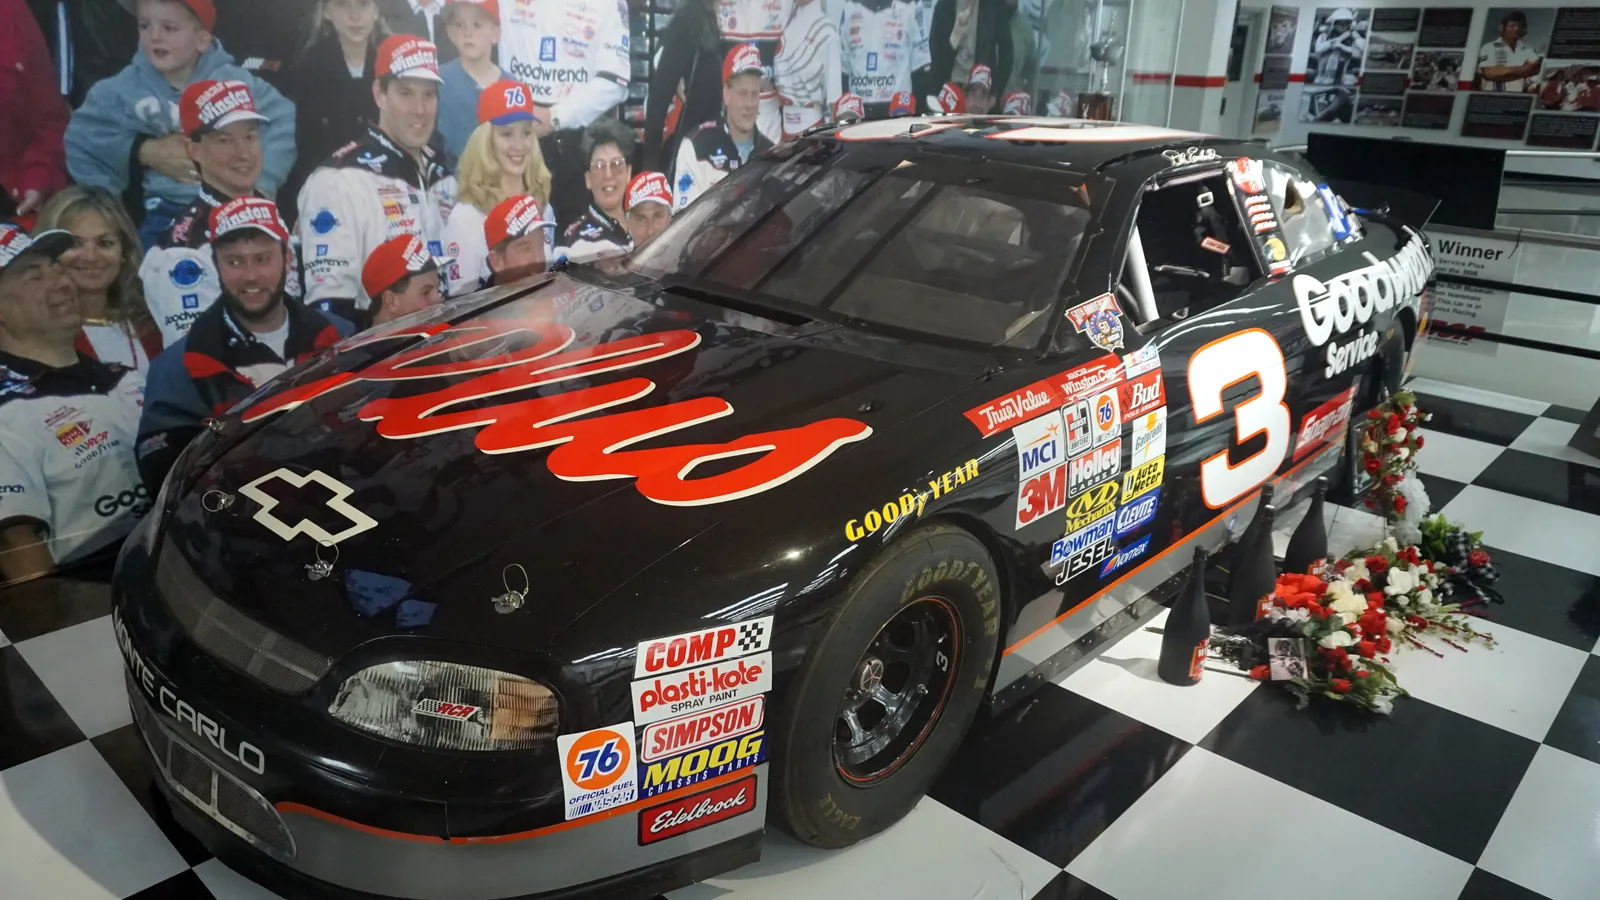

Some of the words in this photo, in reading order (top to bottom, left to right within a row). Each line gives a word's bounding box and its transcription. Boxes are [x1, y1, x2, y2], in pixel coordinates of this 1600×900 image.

[510, 56, 588, 83] Goodwrench
[504, 87, 524, 105] 76
[1438, 239, 1504, 260] Winner
[1325, 328, 1379, 380] Service
[1061, 374, 1097, 395] Winston
[1132, 373, 1161, 409] Bud
[1099, 402, 1112, 424] 76
[1187, 328, 1291, 510] 3
[1022, 439, 1057, 473] MCI
[1070, 445, 1120, 487] Holley
[1136, 461, 1159, 481] Auto
[1018, 463, 1067, 524] 3M
[1070, 473, 1108, 495] CARBS
[1133, 472, 1161, 494] Meter
[1052, 518, 1114, 563] Bowman
[1056, 537, 1115, 585] JESEL
[1113, 541, 1148, 570] Nomex
[114, 605, 155, 698] MONTE
[644, 628, 737, 673] COMP
[640, 661, 763, 712] plasti-kote
[671, 698, 706, 714] SPRAY
[709, 690, 738, 704] PAINT
[159, 685, 265, 775] CARLO
[435, 703, 475, 718] RCR
[651, 703, 755, 755] SIMPSON
[574, 737, 622, 783] 76
[643, 731, 765, 789] MOOG
[648, 770, 709, 797] CHASSIS
[718, 753, 760, 776] PARTS
[569, 788, 610, 805] OFFICIAL
[612, 780, 634, 792] FUEL
[650, 787, 747, 834] Edelbrock
